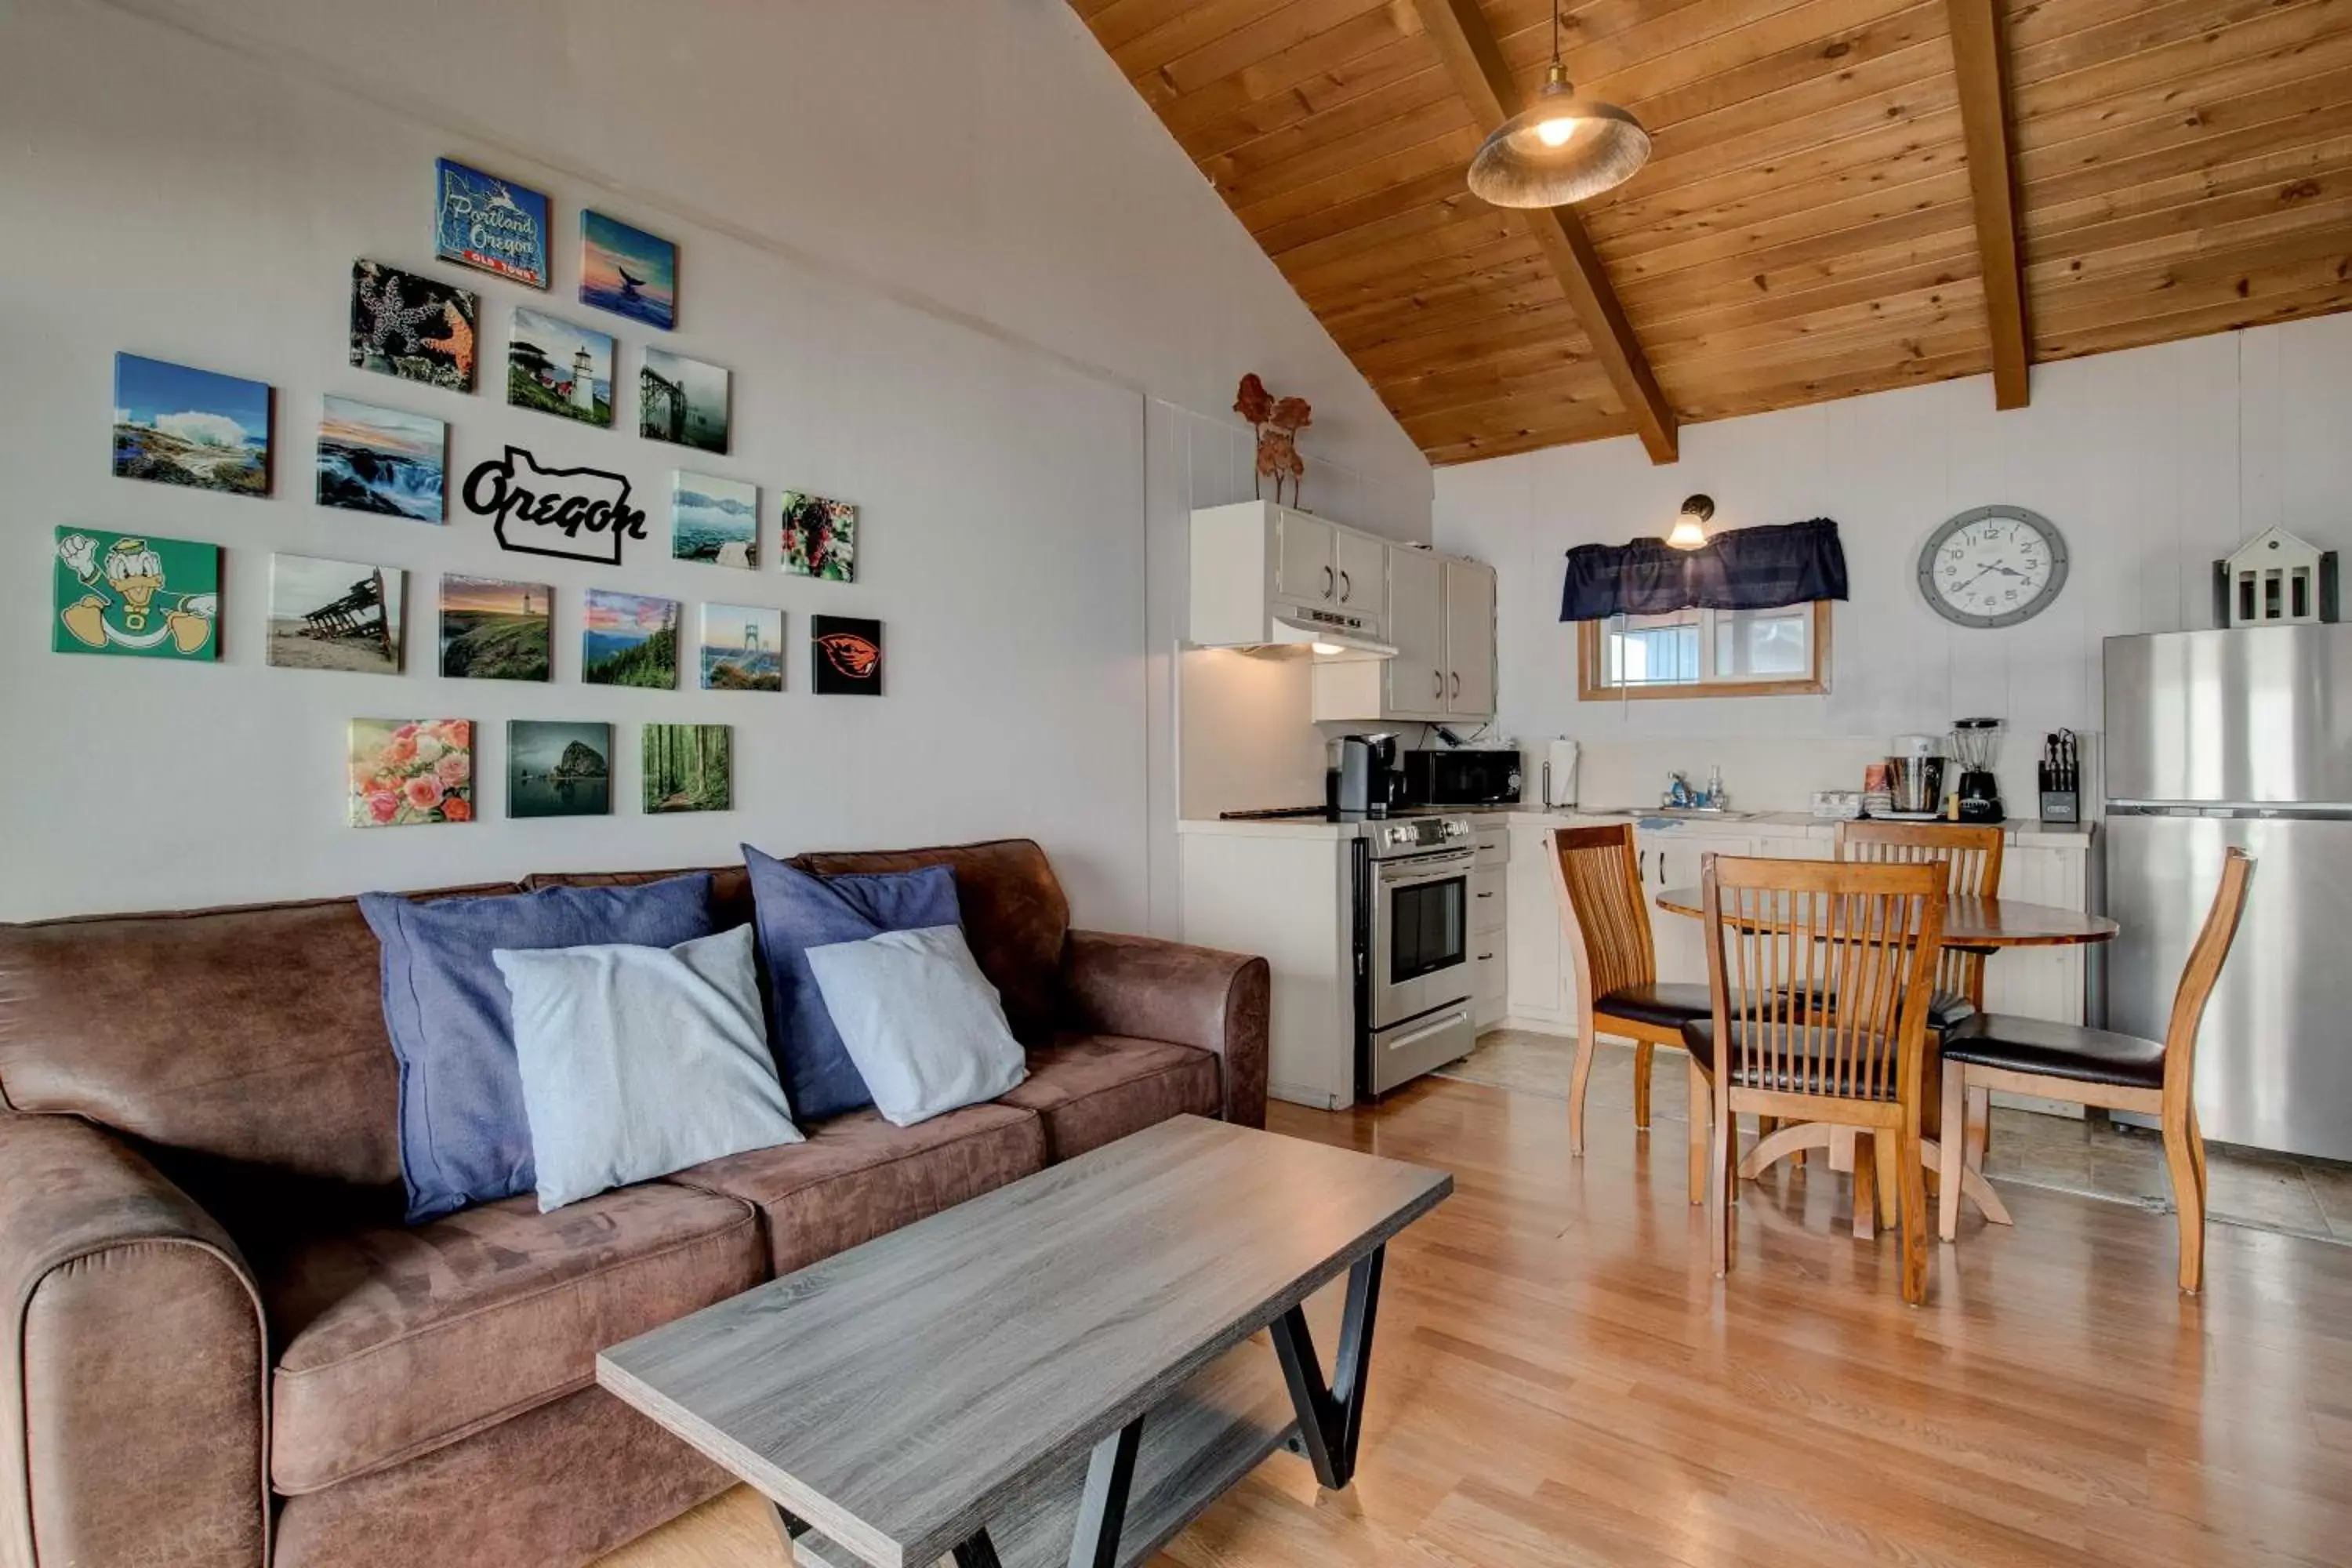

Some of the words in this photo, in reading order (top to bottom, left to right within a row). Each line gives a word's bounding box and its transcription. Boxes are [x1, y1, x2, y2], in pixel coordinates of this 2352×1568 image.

[450, 194, 535, 234] Portland
[470, 224, 535, 256] Oregon
[472, 253, 494, 267] OLD
[502, 263, 531, 279] TOWN
[462, 459, 648, 540] Oregon
[1984, 529, 1999, 539] 12
[1966, 535, 1976, 546] 11
[2020, 542, 2033, 554] 2
[1951, 550, 1964, 561] 10
[2025, 558, 2038, 570] 3
[1944, 565, 1958, 576] 9
[2020, 576, 2032, 586] 4
[1965, 592, 1976, 604] 7
[2005, 590, 2018, 600] 5
[1984, 596, 1996, 606] 6
